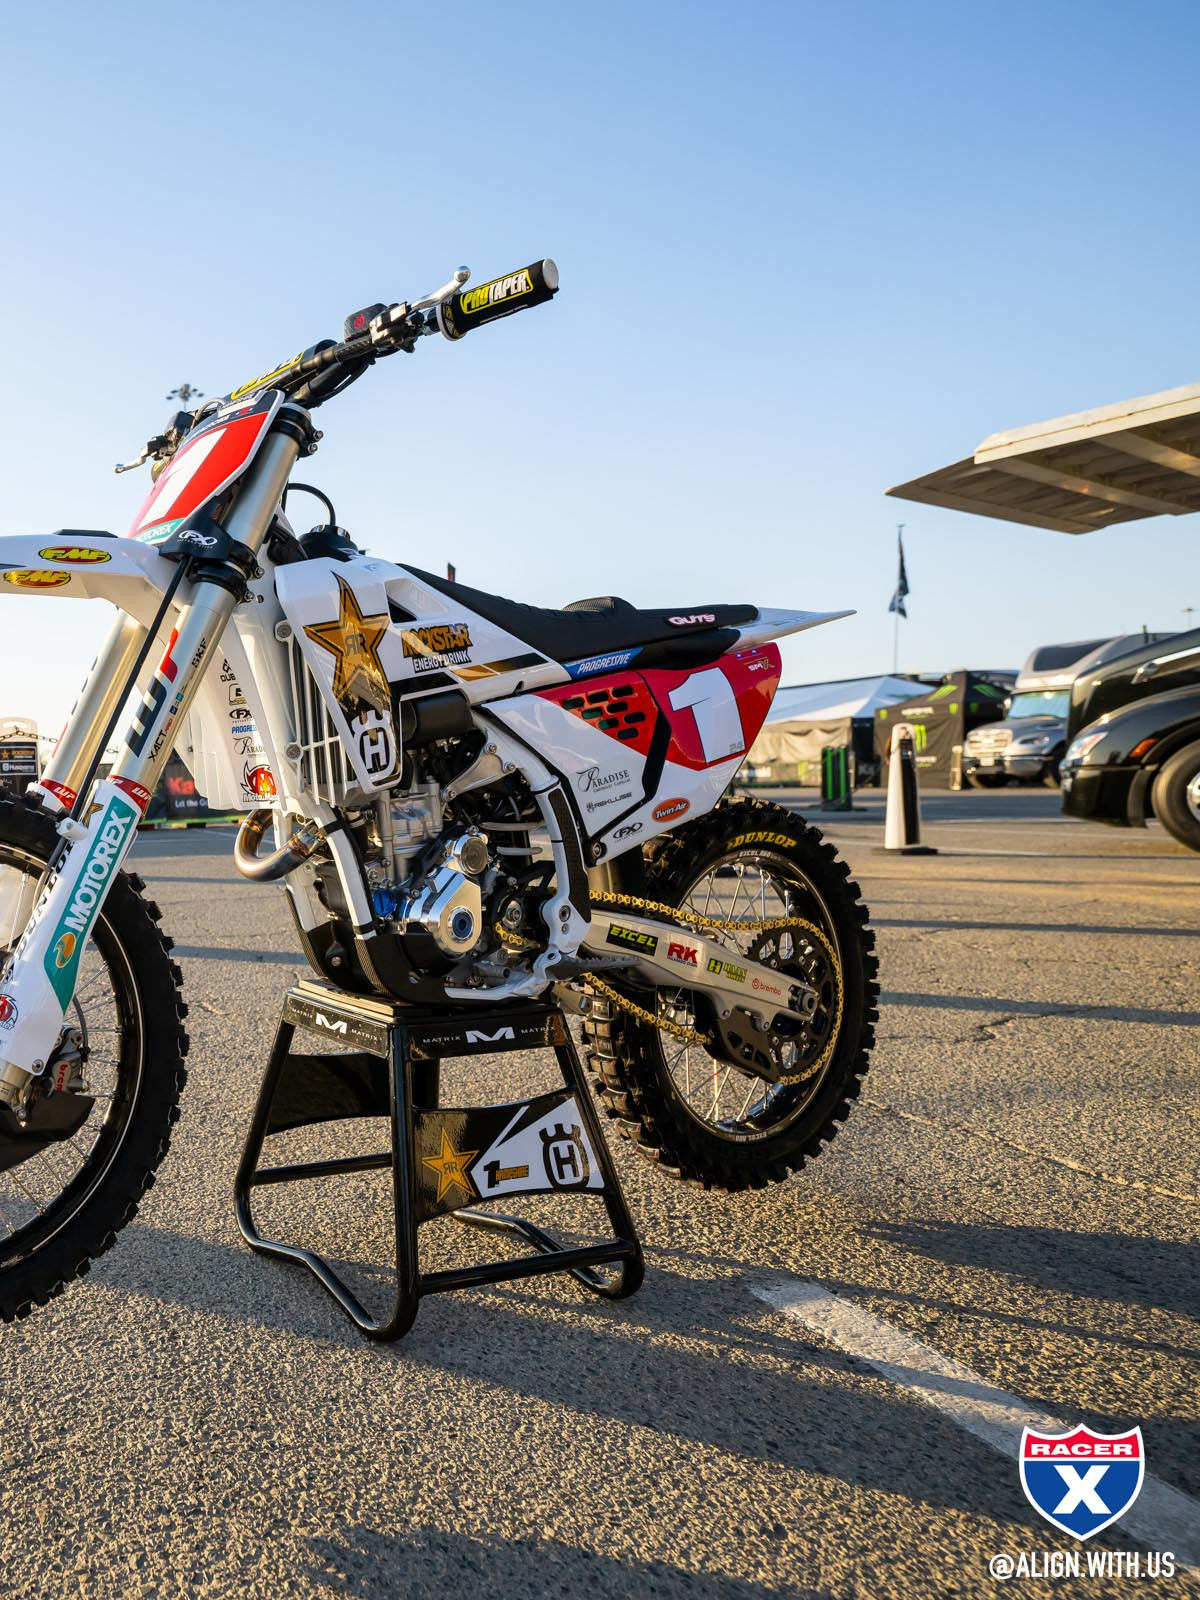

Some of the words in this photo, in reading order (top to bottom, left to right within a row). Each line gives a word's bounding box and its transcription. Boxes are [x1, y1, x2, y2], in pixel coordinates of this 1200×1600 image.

[463, 271, 529, 312] PROTAPER
[42, 548, 110, 560] FMF
[668, 613, 717, 626] GUTS
[400, 622, 474, 658] ROCKSTAR
[191, 637, 207, 668] SKF
[413, 655, 442, 673] ENERGY
[442, 649, 471, 667] DRINK
[576, 652, 632, 675] PROGRESSIVE
[667, 666, 746, 765] 1
[147, 729, 168, 763] XACT
[576, 766, 630, 793] PARADISE
[655, 807, 674, 819] Twin
[675, 800, 688, 812] Air
[732, 831, 797, 849] DUNLOP
[63, 809, 132, 933] MOTOREX
[609, 926, 656, 947] EXCEL
[667, 941, 698, 964] RK
[759, 981, 782, 996] brembo
[351, 1028, 378, 1041] MATRIX
[422, 1035, 461, 1044] MATRIX
[495, 1164, 529, 1182] HAMPSHIRE
